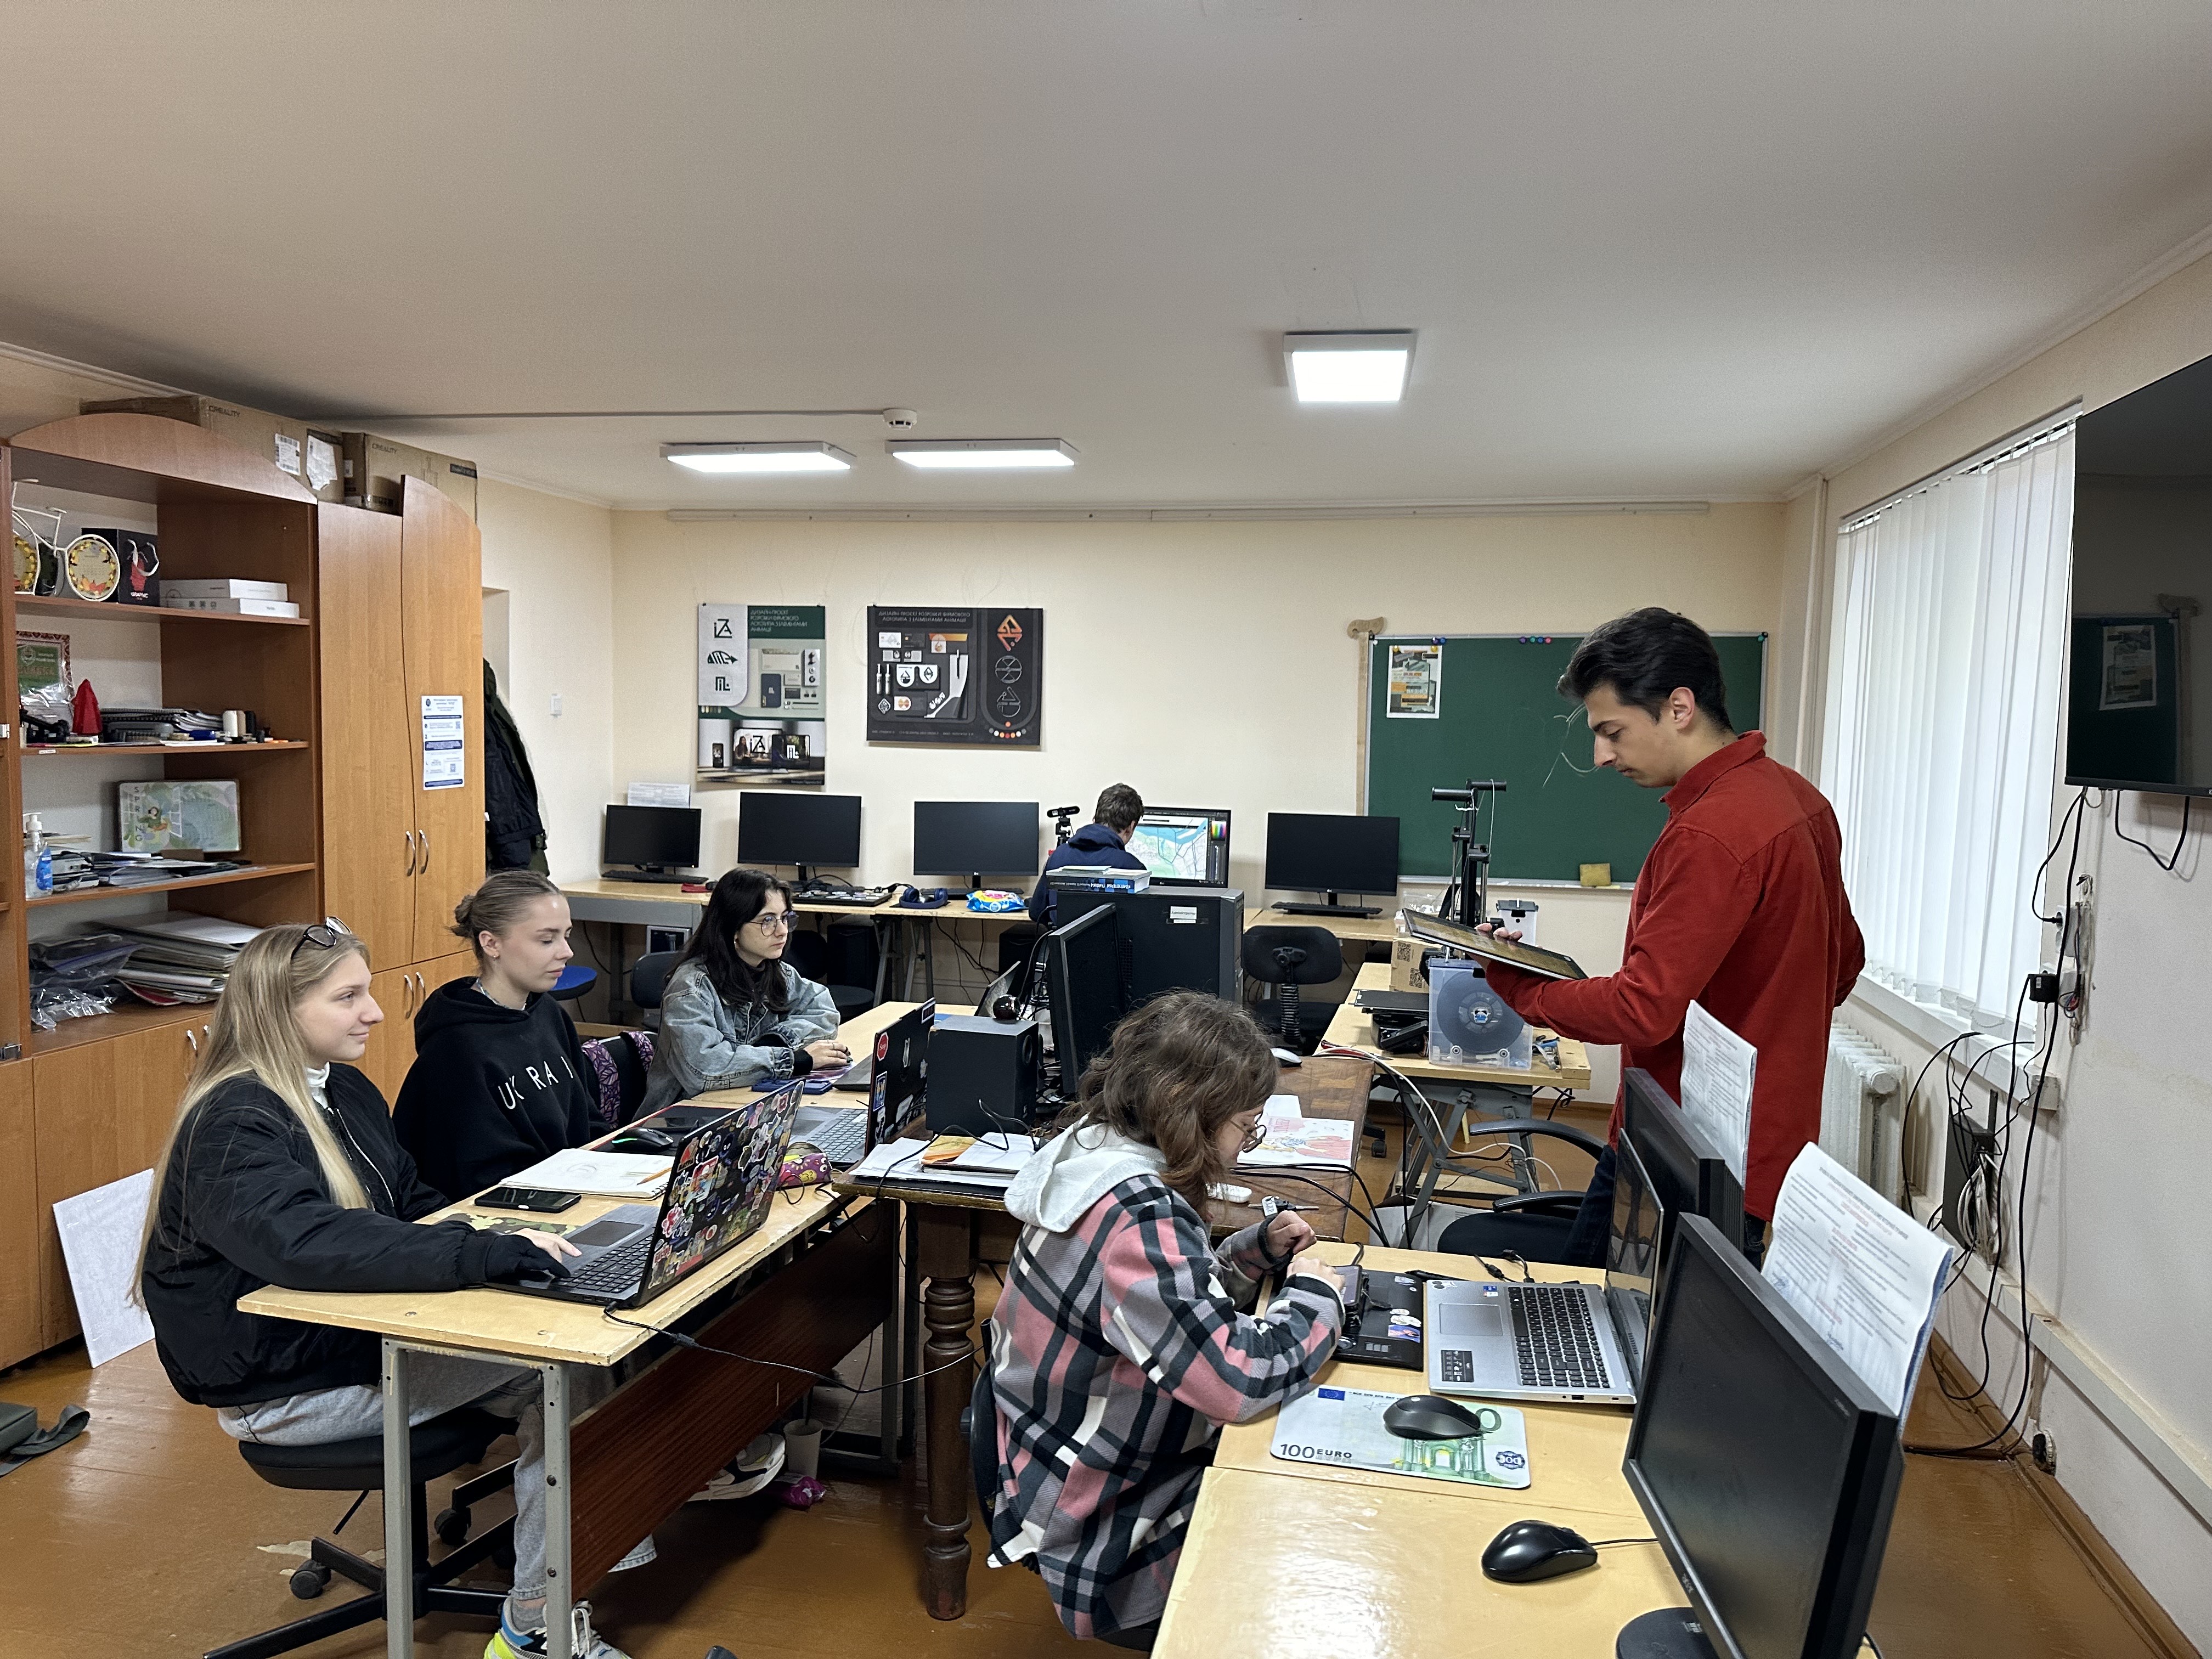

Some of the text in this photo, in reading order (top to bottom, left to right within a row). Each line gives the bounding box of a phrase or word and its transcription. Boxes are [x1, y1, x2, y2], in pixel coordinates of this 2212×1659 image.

[208, 405, 240, 417] CREALITY
[372, 443, 398, 454] CREALITY
[1280, 1443, 1352, 1458] 100 EURO
